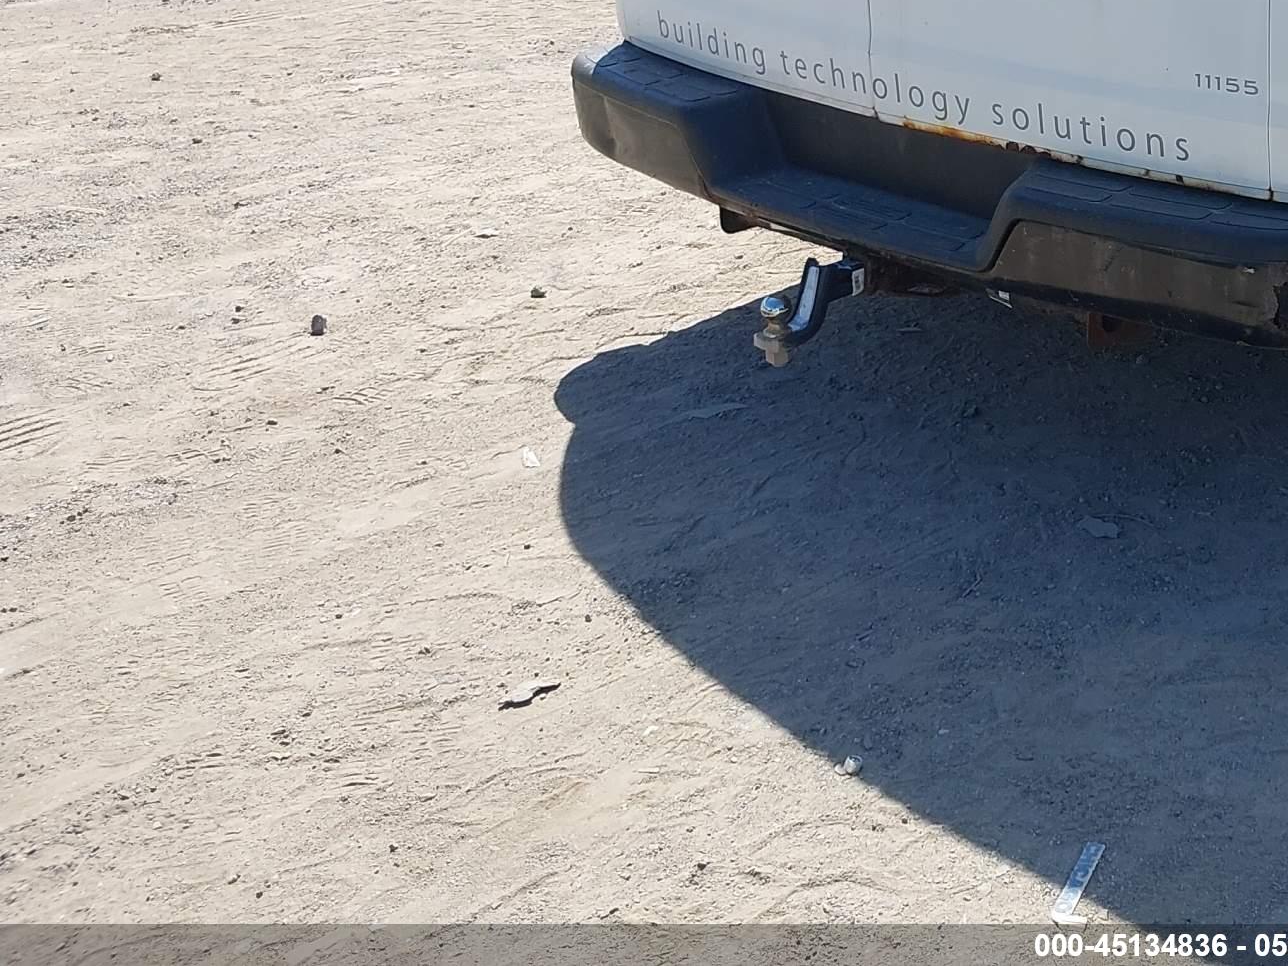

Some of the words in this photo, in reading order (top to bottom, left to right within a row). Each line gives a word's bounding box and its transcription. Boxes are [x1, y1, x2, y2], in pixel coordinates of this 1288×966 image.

[656, 9, 766, 76] building
[779, 50, 970, 126] technology
[991, 102, 1190, 162] solutions
[1194, 73, 1259, 96] 11155
